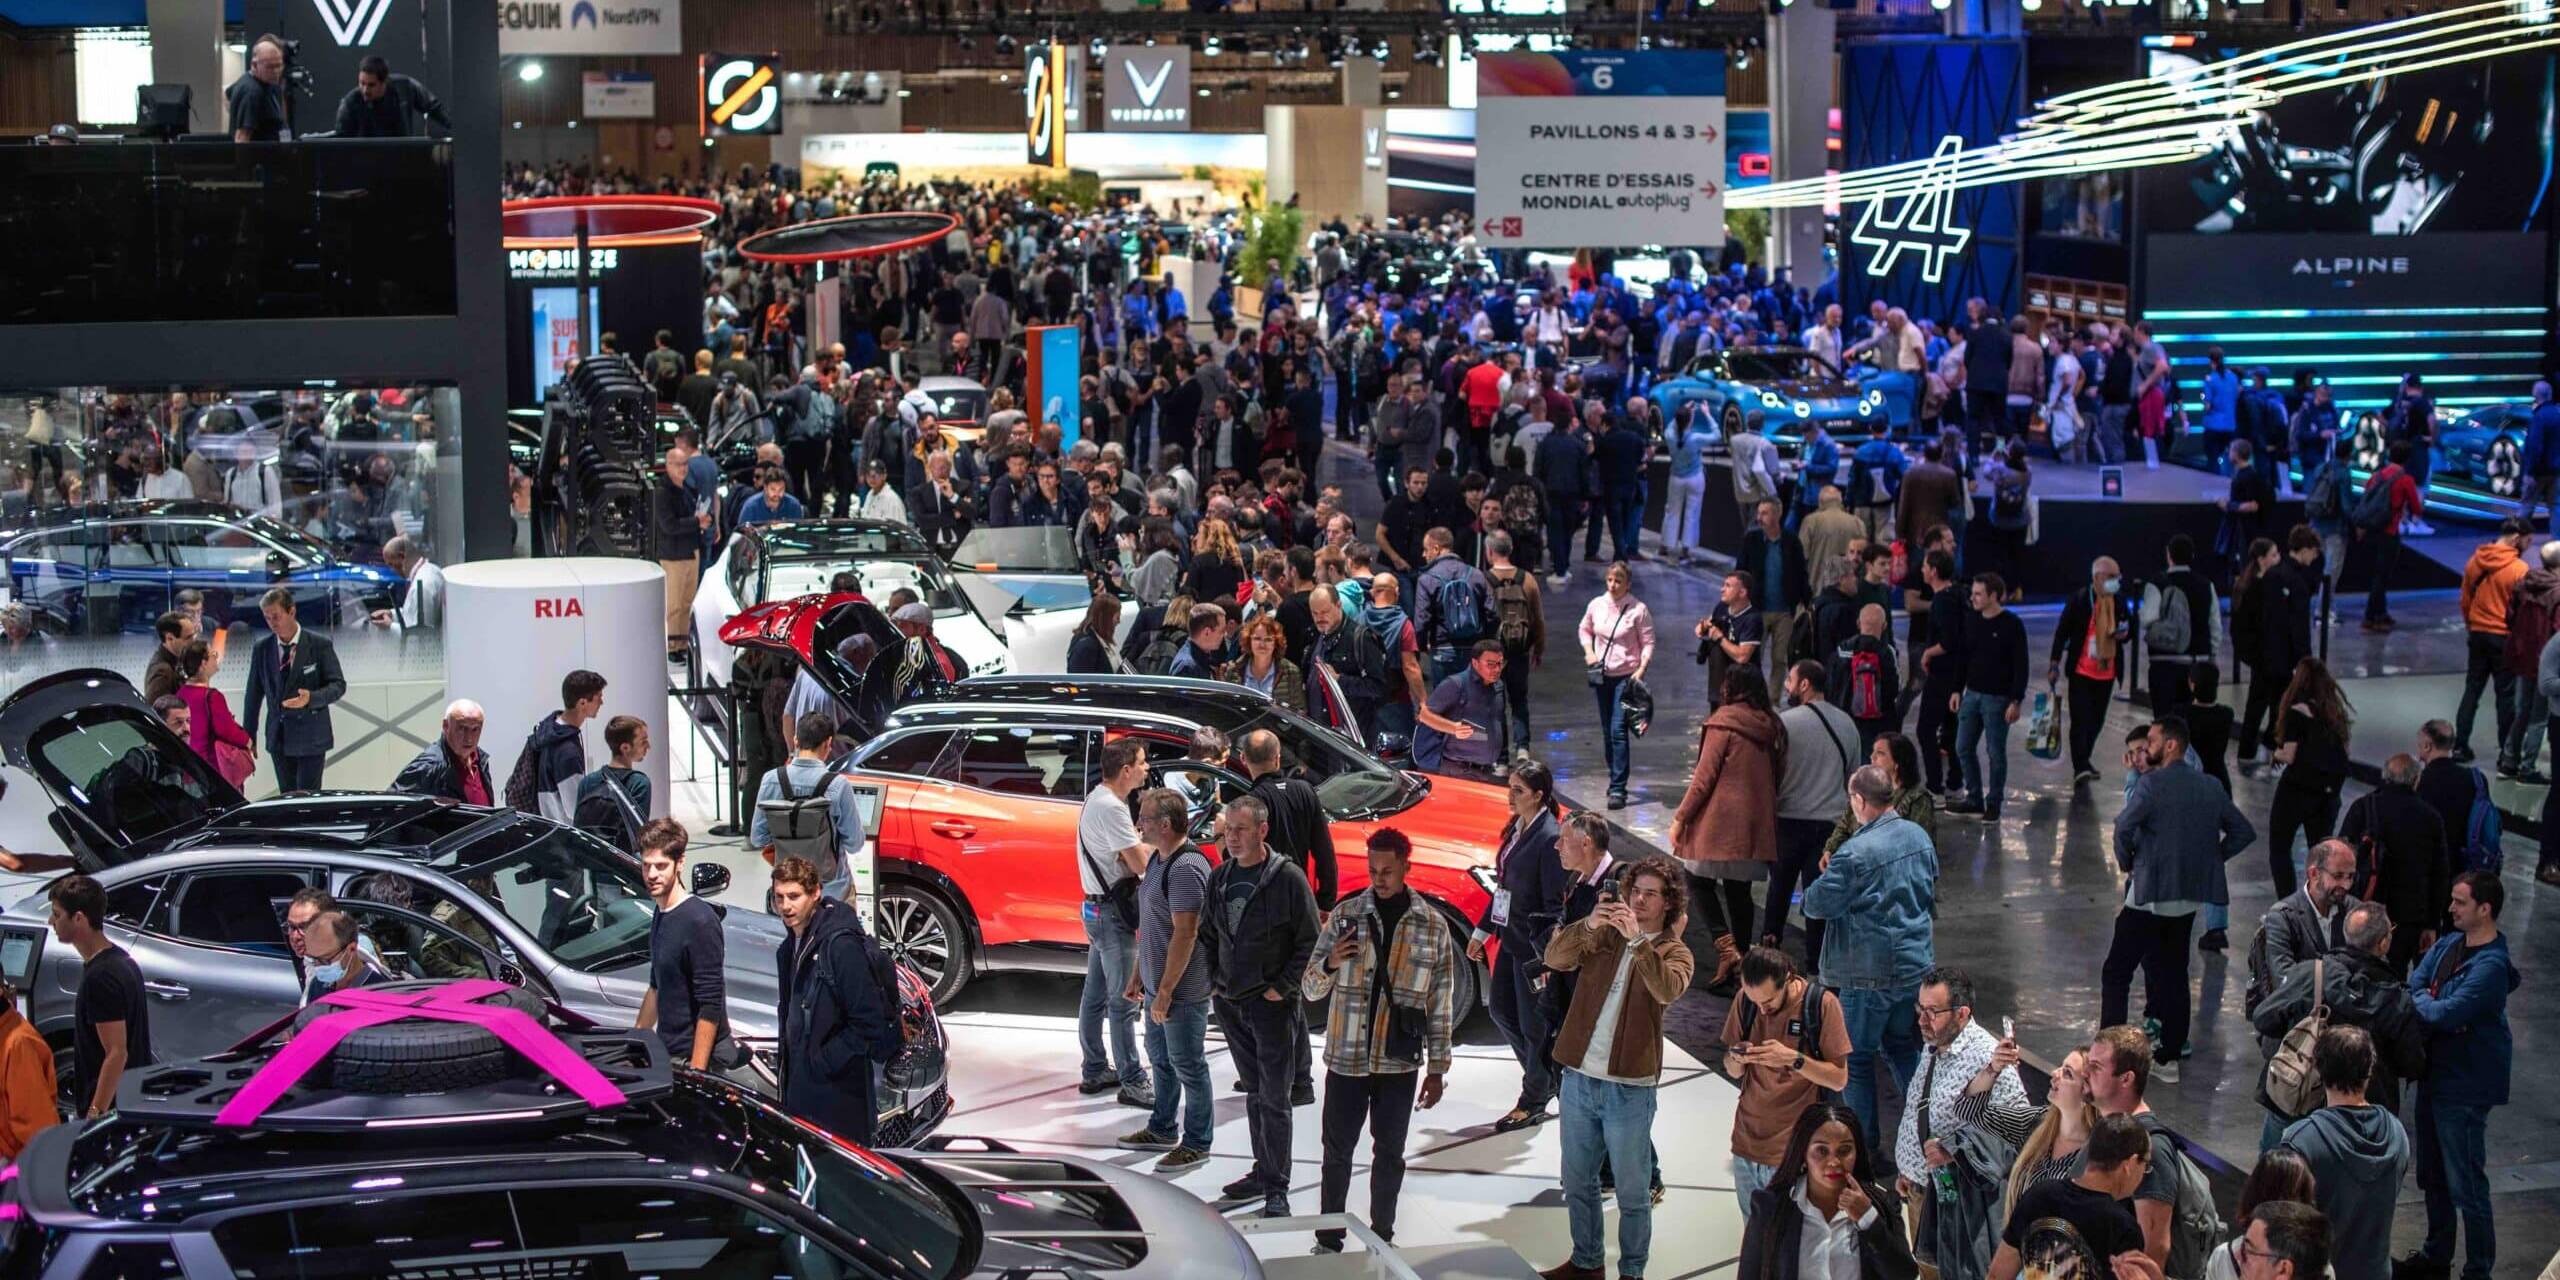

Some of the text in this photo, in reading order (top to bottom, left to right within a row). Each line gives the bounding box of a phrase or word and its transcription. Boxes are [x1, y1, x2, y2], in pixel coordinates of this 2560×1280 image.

[603, 8, 661, 24] NordVPN
[1592, 65, 1613, 90] 6
[1111, 108, 1186, 121] VINFAST
[1530, 125, 1695, 139] PAVILLONS 4 & 3
[1521, 174, 1695, 188] CENTRE D'ESSAIS
[1522, 195, 1614, 209] MONDIAL
[2292, 256, 2410, 274] ALPINE
[535, 598, 584, 618] RIA
